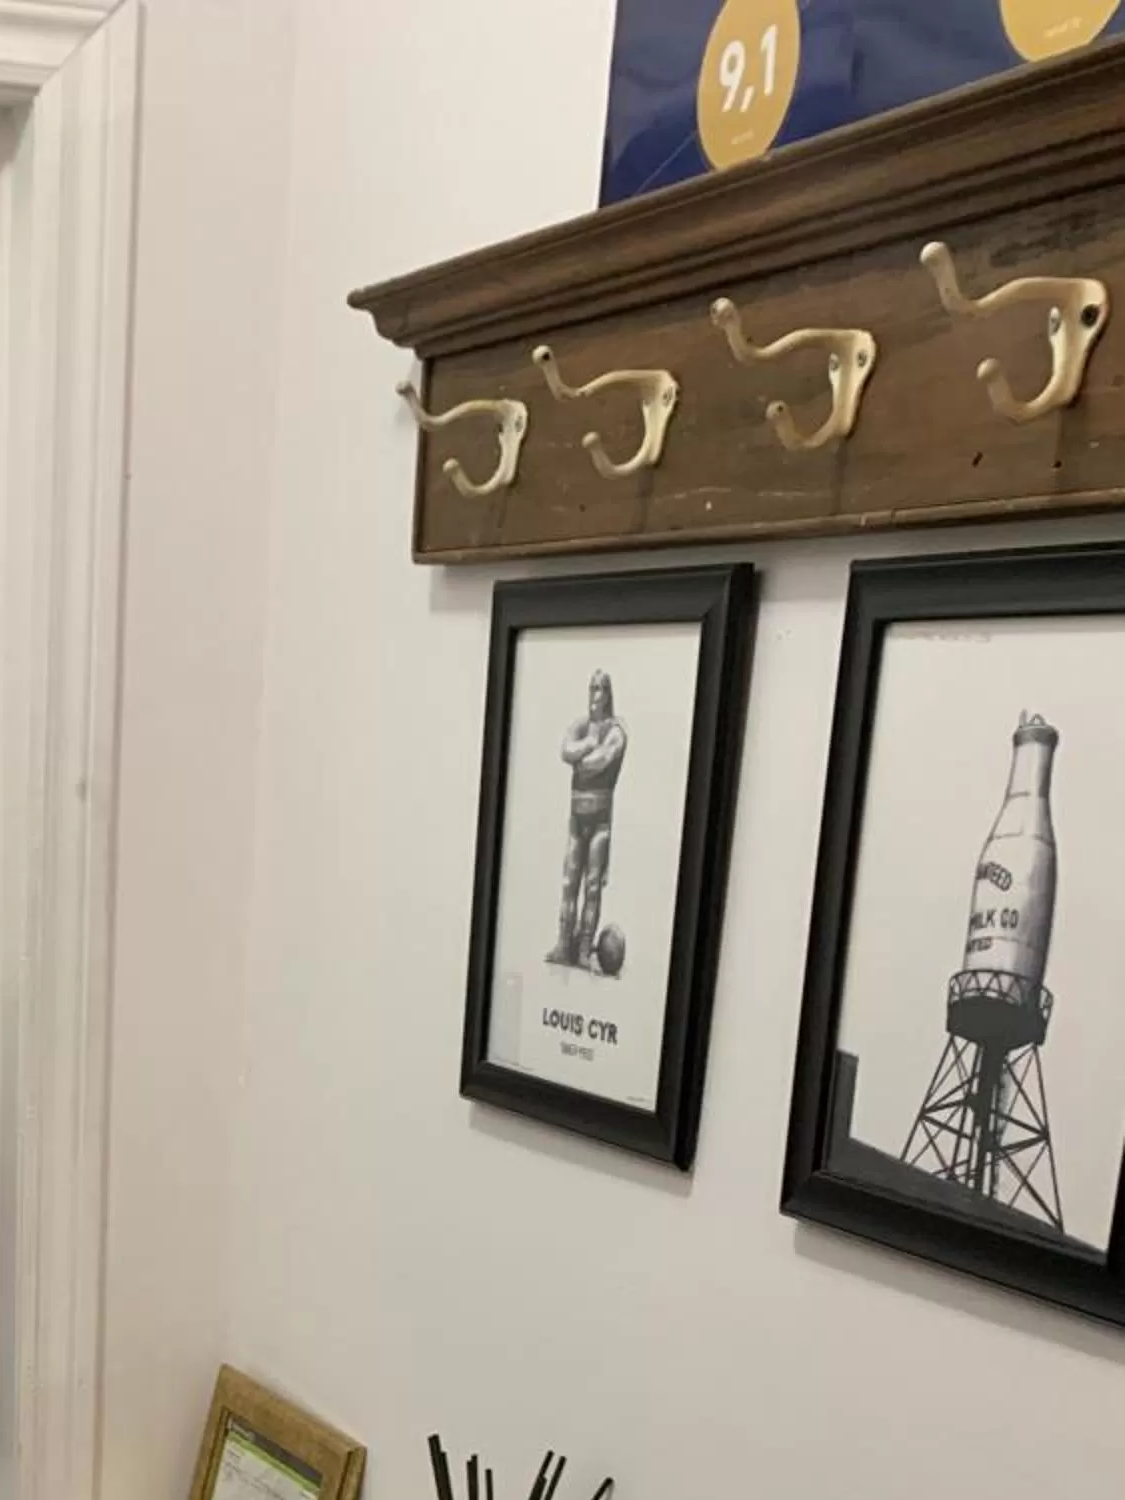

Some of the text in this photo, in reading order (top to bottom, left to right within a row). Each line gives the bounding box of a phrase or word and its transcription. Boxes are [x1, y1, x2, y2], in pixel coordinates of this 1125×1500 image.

[719, 23, 779, 113] 9,1
[542, 1007, 618, 1045] LOUIS CYR
